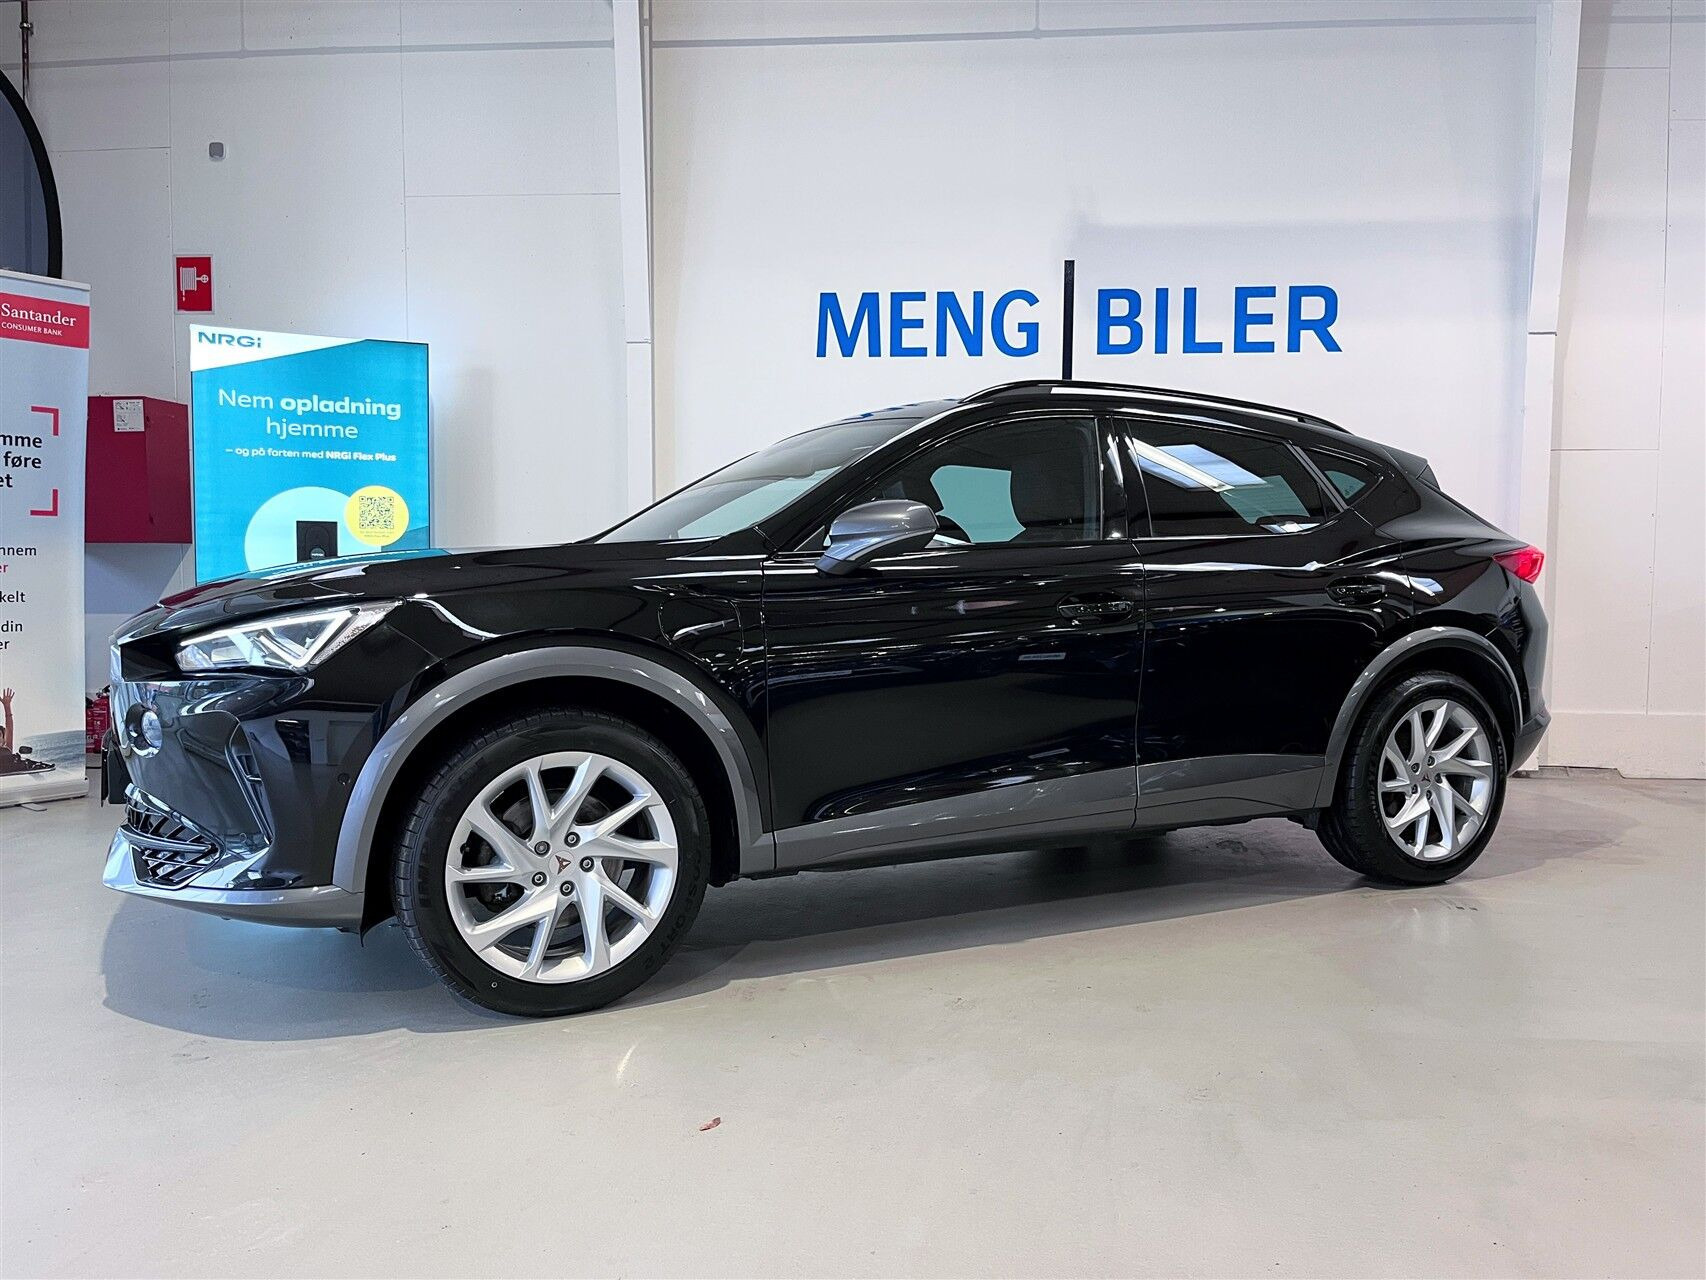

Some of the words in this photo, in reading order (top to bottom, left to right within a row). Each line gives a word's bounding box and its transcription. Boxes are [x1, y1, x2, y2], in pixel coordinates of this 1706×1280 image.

[1, 303, 77, 327] Santander
[816, 289, 1040, 358] MENG
[1096, 285, 1342, 354] BILER
[1, 321, 42, 334] CONSUMER
[43, 327, 63, 336] BANK
[198, 331, 261, 348] NRGi
[218, 388, 274, 410] Nem
[280, 394, 402, 421] opladning
[266, 416, 359, 440] hjemme
[3, 450, 42, 469] føre
[235, 447, 250, 457] og
[252, 447, 266, 457] på
[302, 450, 324, 459] med
[353, 452, 374, 461] Flex
[375, 452, 397, 462] Plus
[1, 620, 23, 632] din
